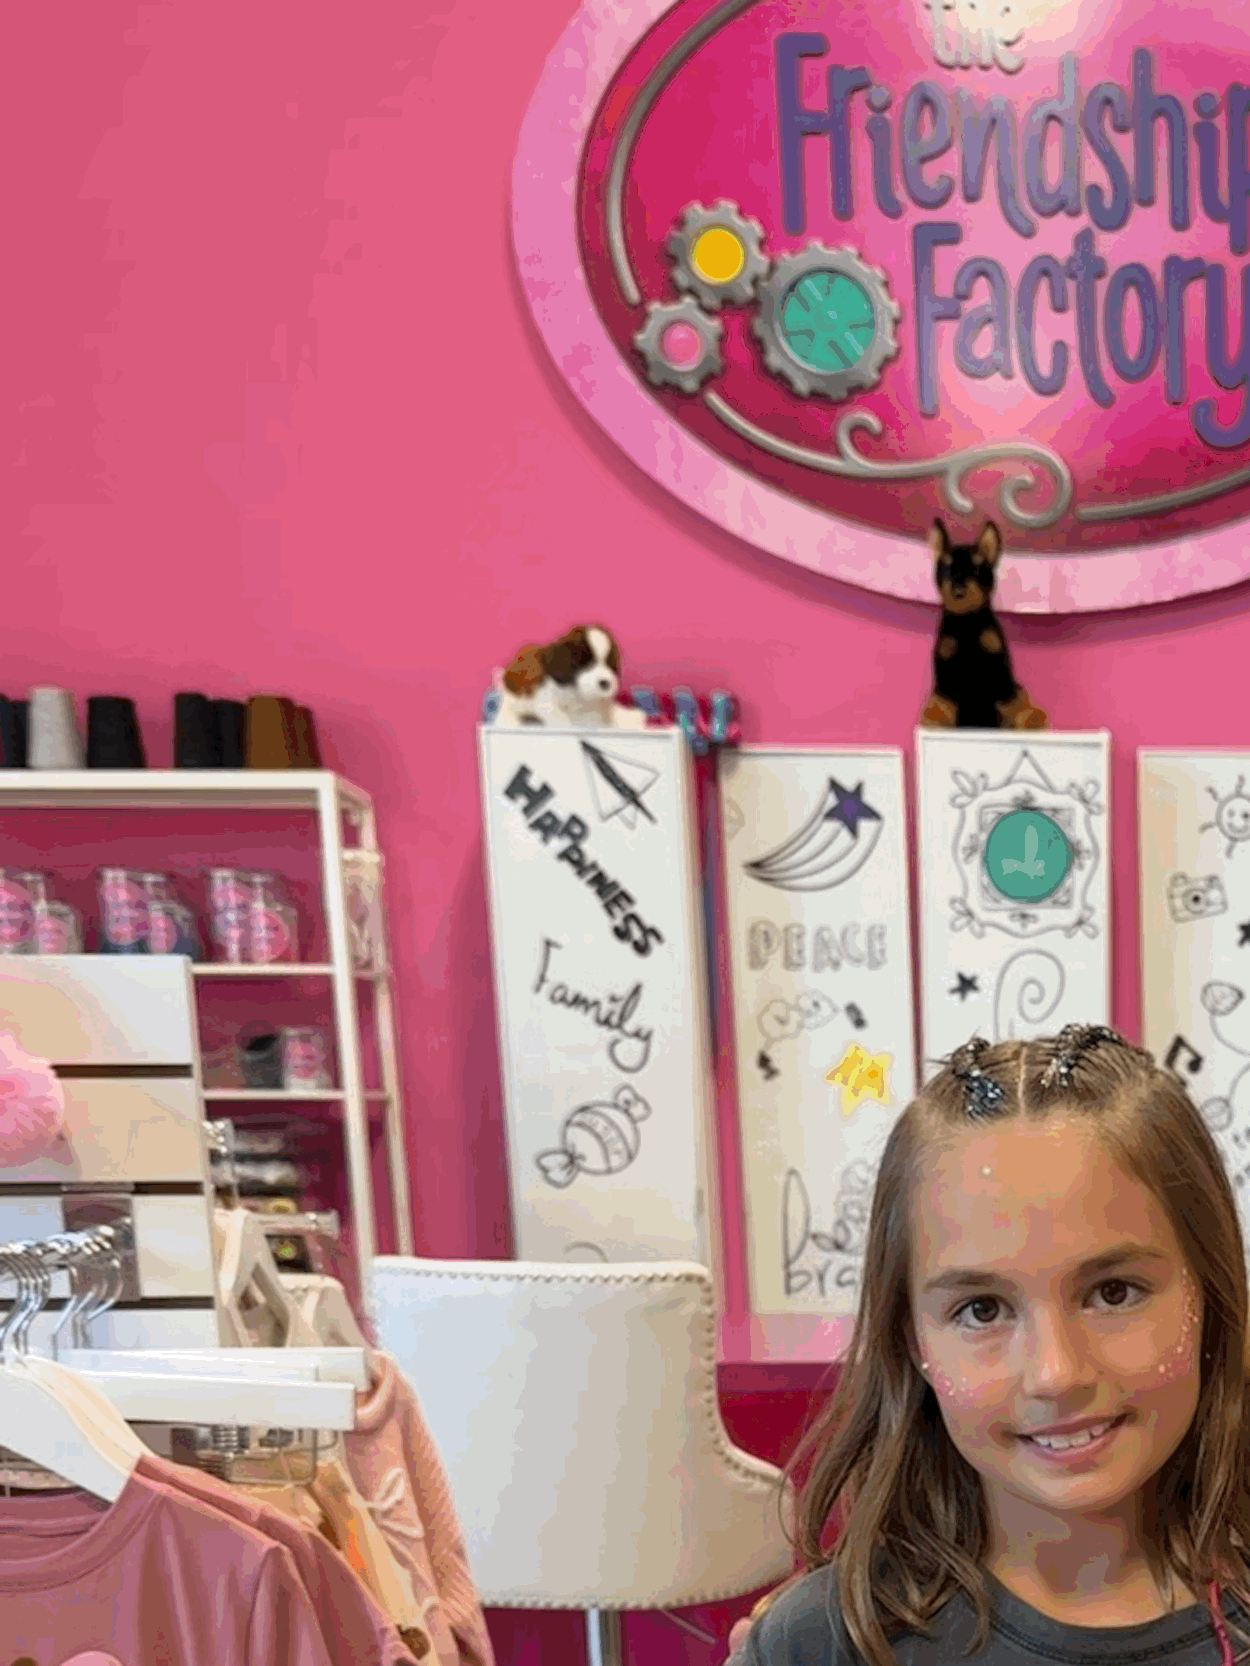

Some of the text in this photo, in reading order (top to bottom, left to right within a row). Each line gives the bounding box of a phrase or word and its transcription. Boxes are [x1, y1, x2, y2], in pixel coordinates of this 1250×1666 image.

[926, 0, 1026, 74] the
[502, 763, 665, 958] HAPPINESS
[746, 919, 889, 974] PEACE
